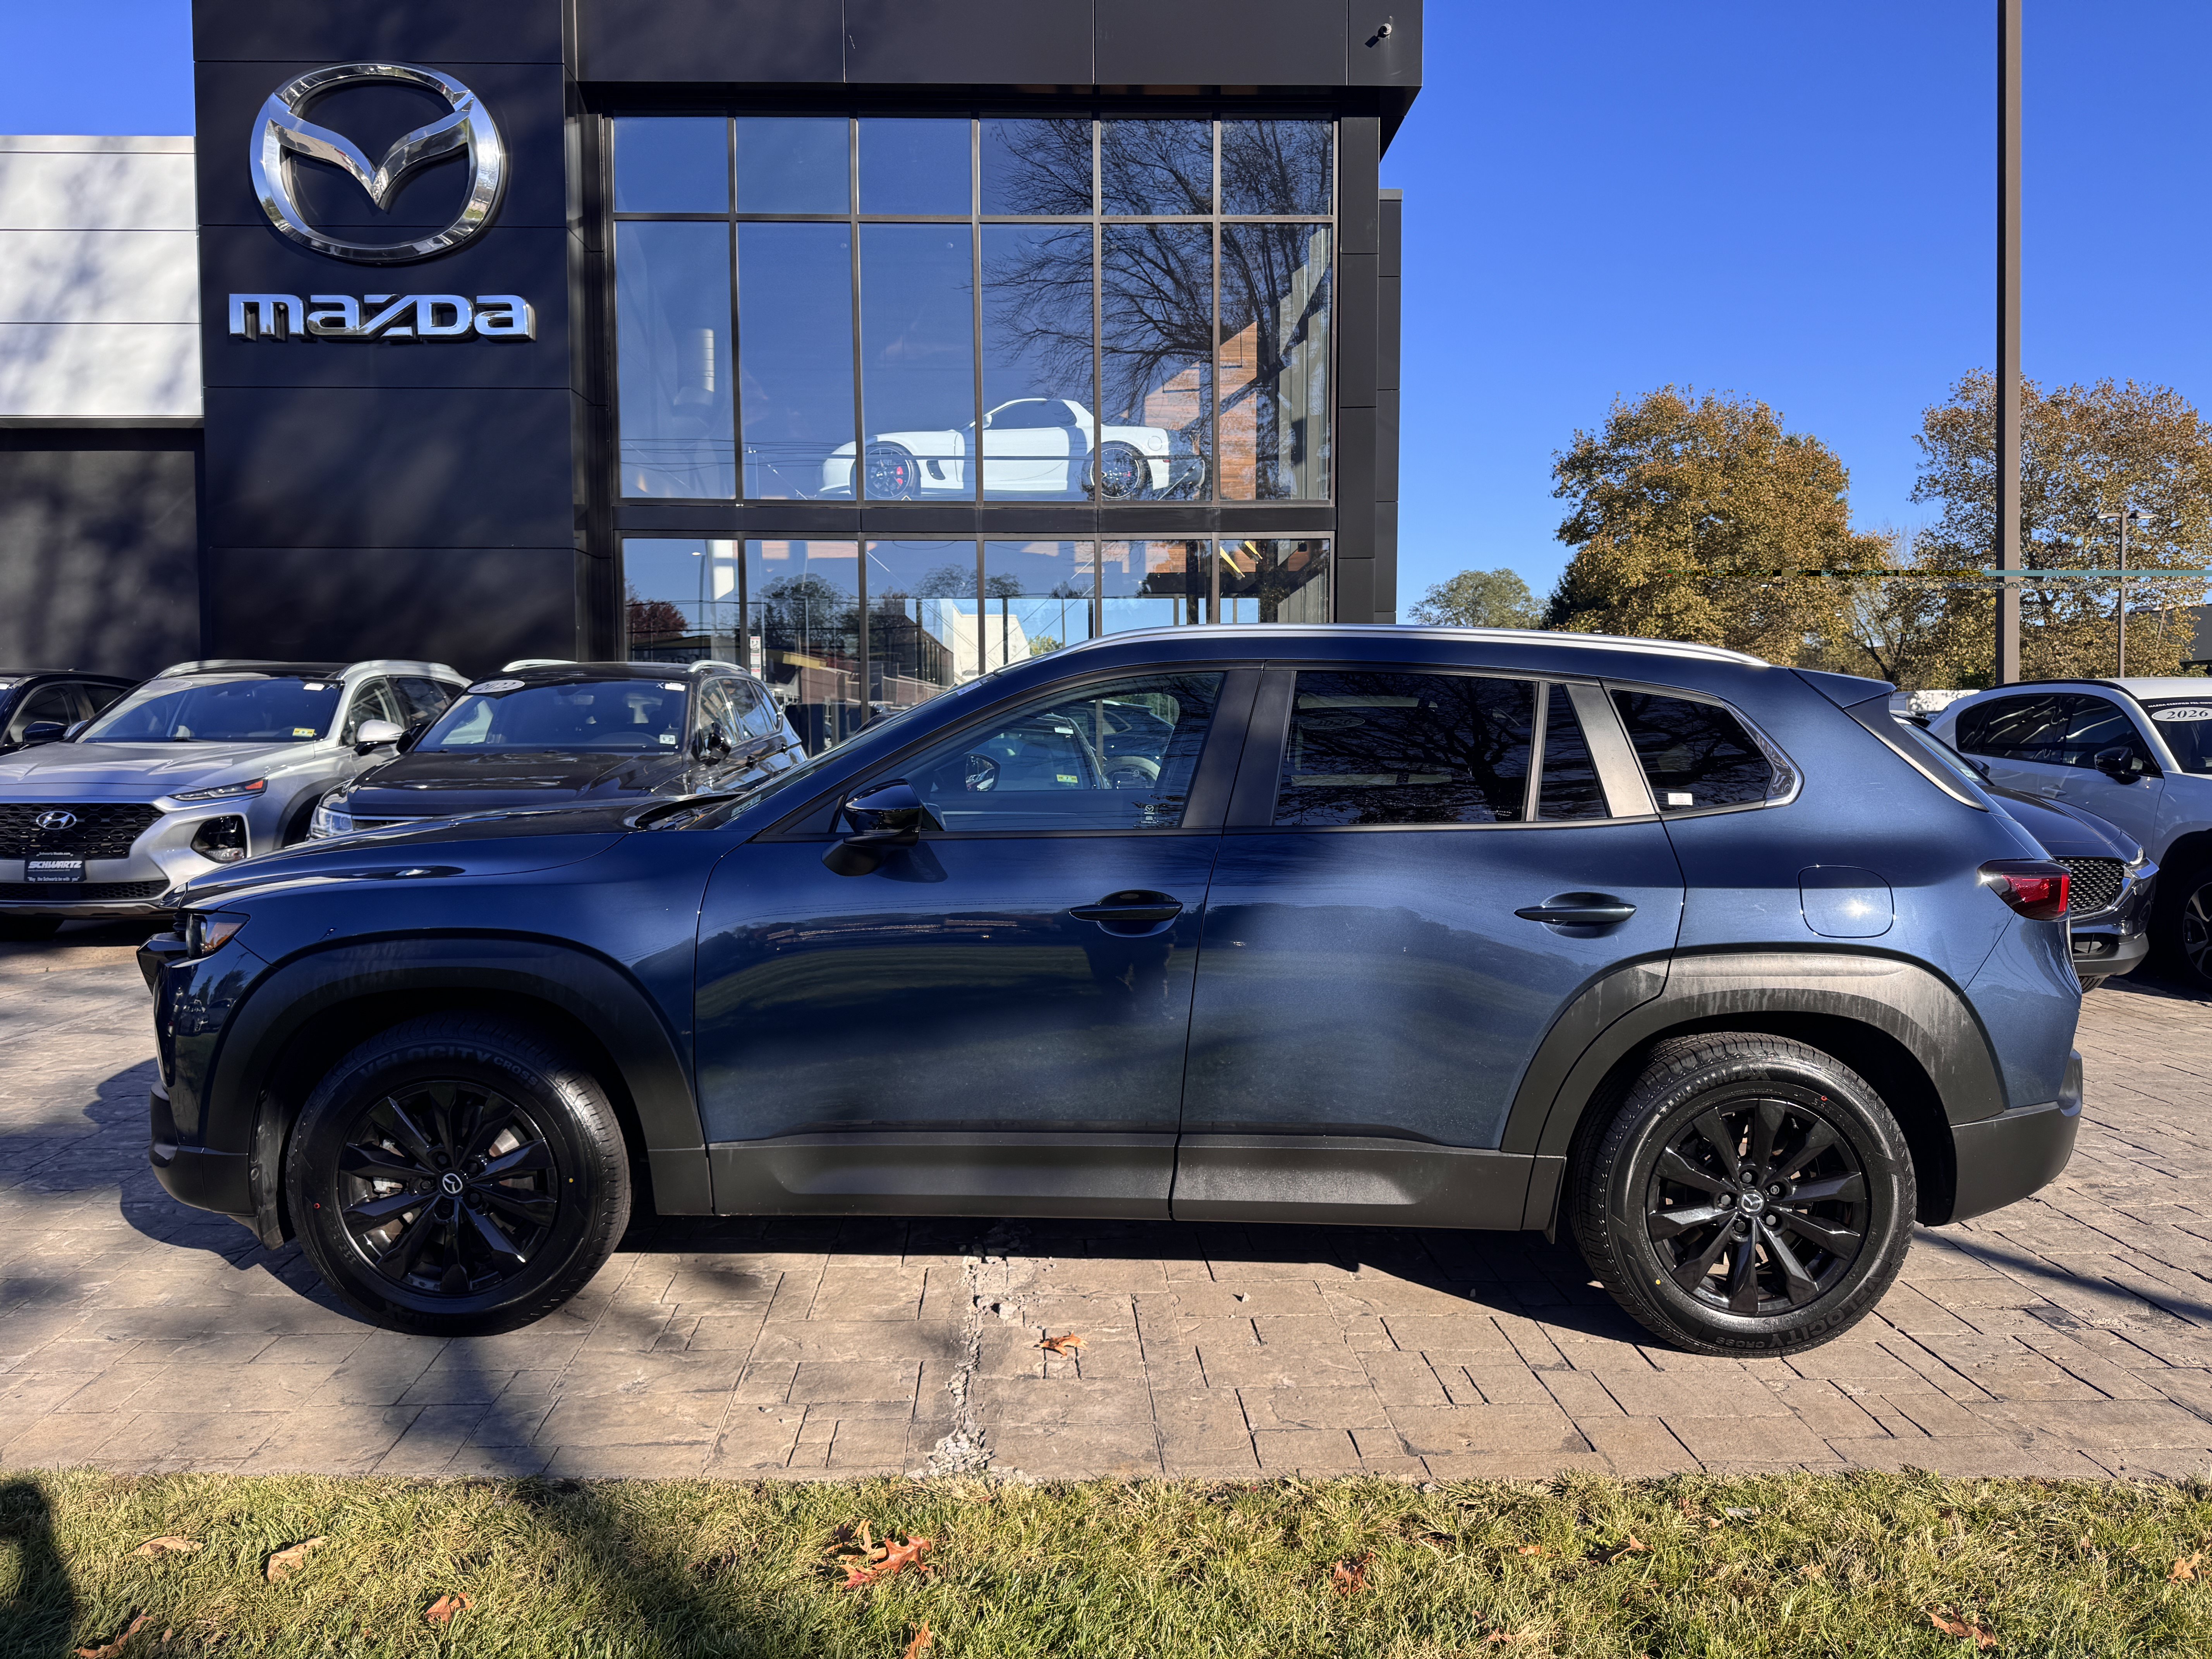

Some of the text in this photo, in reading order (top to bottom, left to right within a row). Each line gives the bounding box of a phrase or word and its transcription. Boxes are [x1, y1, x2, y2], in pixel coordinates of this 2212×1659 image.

[2166, 709, 2209, 720] 2026
[28, 860, 82, 869] SCHWARTZ
[358, 1045, 539, 1087] VELOCITY CROSS
[1767, 1276, 1884, 1349] VELOCITY
[1715, 1336, 1765, 1349] CROSS
